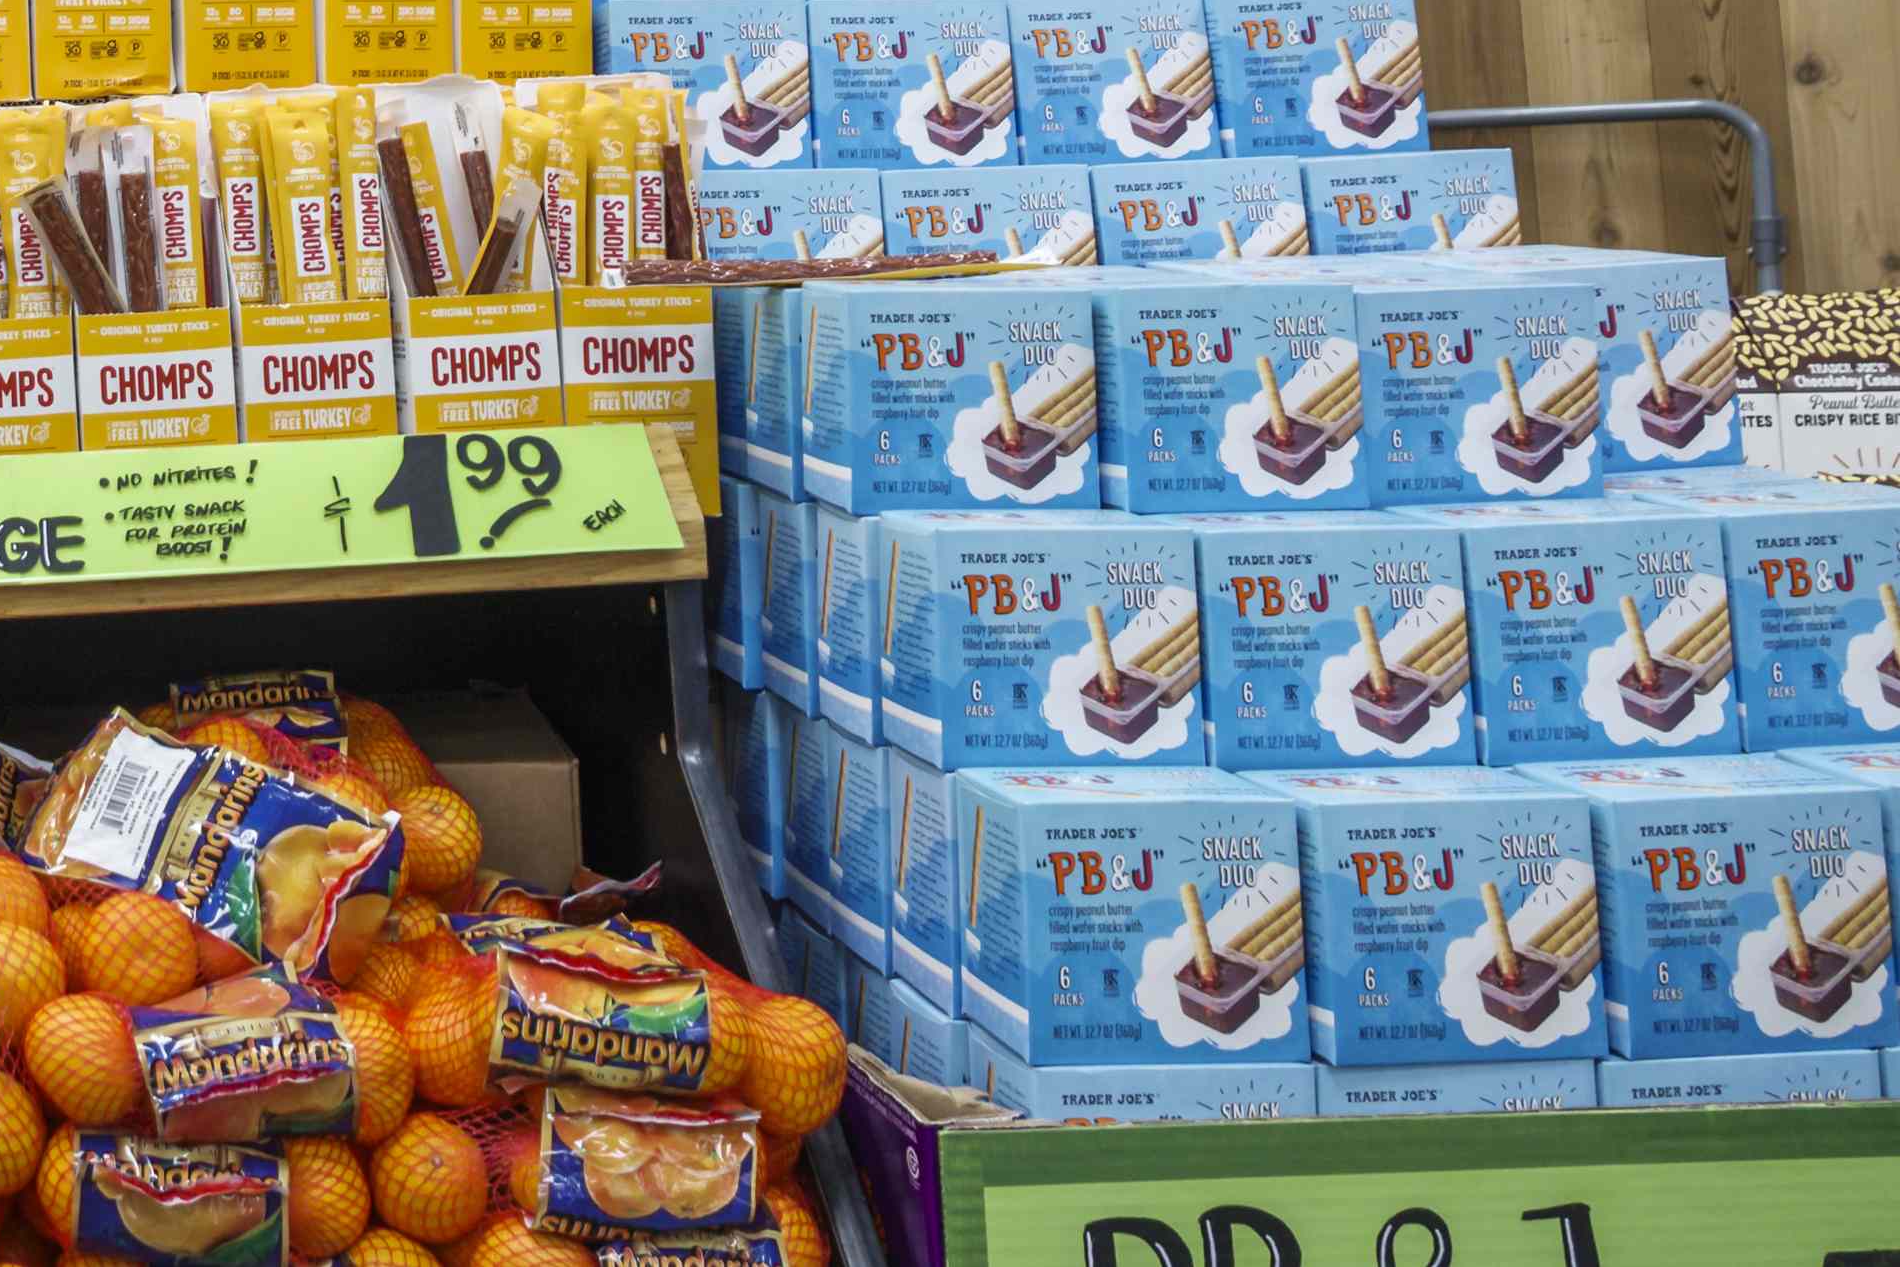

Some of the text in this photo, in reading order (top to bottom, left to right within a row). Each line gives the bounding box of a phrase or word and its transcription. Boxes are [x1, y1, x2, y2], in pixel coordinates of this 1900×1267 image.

[1009, 322, 1062, 342] SNACK
[432, 342, 541, 386] CHOMPS
[583, 335, 694, 375] CHOMPS
[1023, 346, 1058, 366] DUO
[100, 360, 213, 405] CHOMPS
[263, 351, 374, 394] CHOMPS
[471, 398, 519, 421] TURKEY
[622, 389, 671, 413] TURKEY
[1809, 394, 1858, 409] Peanut
[1795, 414, 1844, 427] CRISPY
[1850, 414, 1880, 425] RICE
[116, 472, 144, 492] NO
[119, 498, 246, 523] TASTY SNACK
[581, 499, 626, 532] EACH
[125, 519, 248, 542] FOR PROTEIN
[961, 553, 1044, 563] TRADER JOE'S
[1637, 551, 1693, 574] SNACK
[1107, 562, 1164, 584] SNACK
[1123, 589, 1158, 609] DUO
[1654, 577, 1689, 598] DUO
[177, 765, 266, 907] Mandarins
[1046, 828, 1137, 840] TRADER JOE'S
[1640, 822, 1728, 837] TRADER JOE'S
[1792, 826, 1851, 852] SNACK
[1203, 837, 1263, 860] SNACK
[1219, 865, 1256, 887] DUO
[1809, 855, 1846, 878] DUO
[1107, 903, 1132, 916] butter
[1124, 921, 1143, 932] with
[1113, 939, 1125, 953] dip
[1060, 966, 1070, 990] 6
[1053, 994, 1085, 1007] PACKS
[501, 1011, 705, 1077] Mandarins
[154, 1032, 348, 1094] Mandarins
